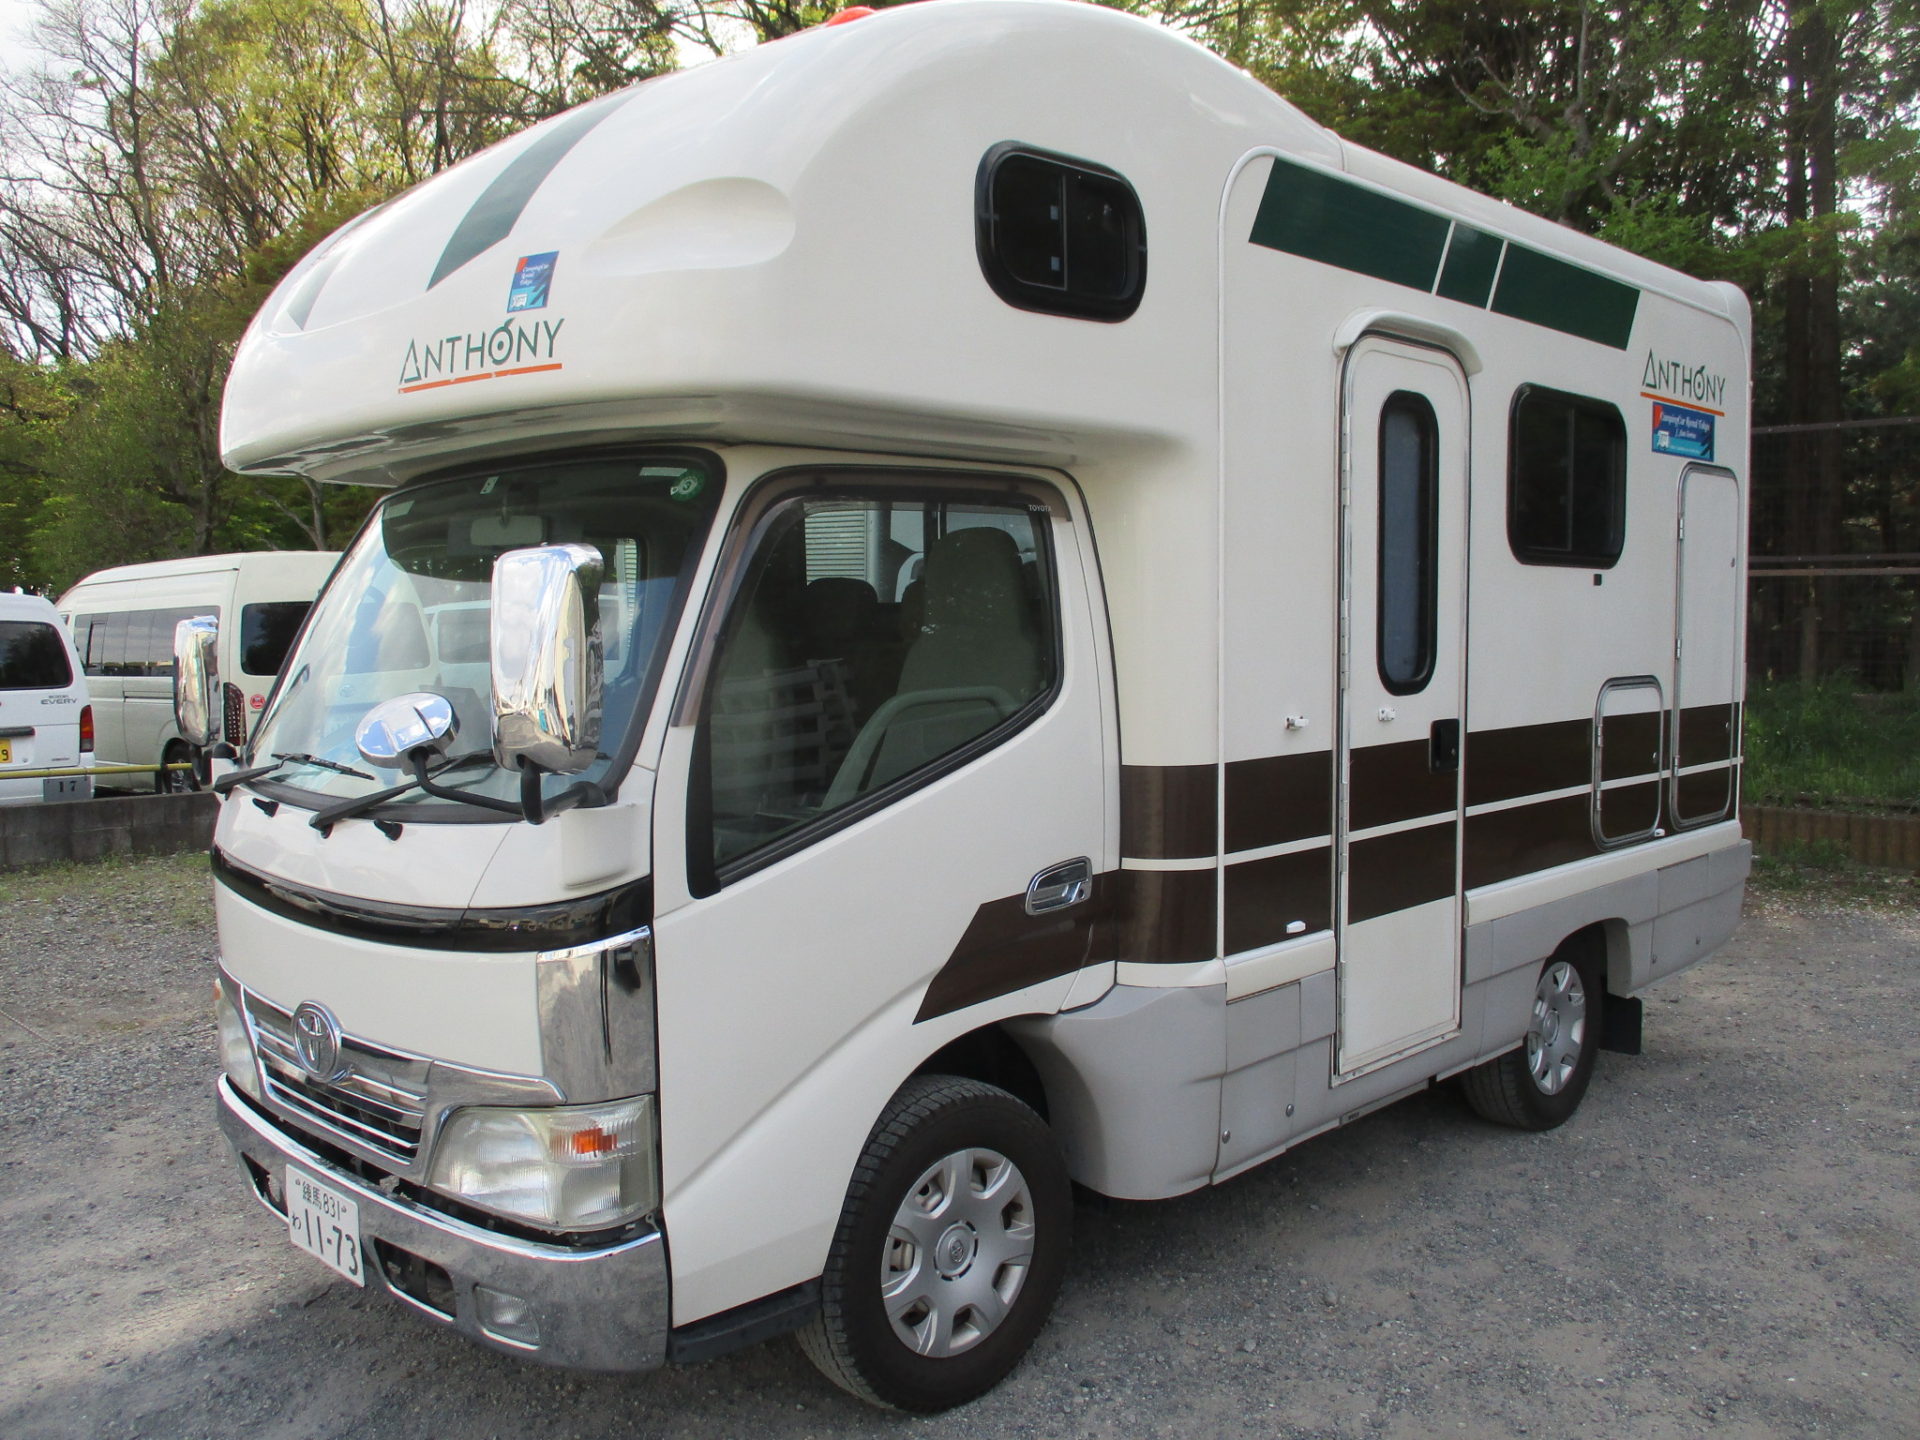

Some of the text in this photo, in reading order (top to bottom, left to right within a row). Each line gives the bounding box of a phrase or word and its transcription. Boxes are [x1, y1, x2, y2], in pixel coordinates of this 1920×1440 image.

[399, 317, 565, 384] ANTHONY
[1642, 348, 1726, 406] ANTHONY
[1029, 504, 1052, 512] TOYOTA
